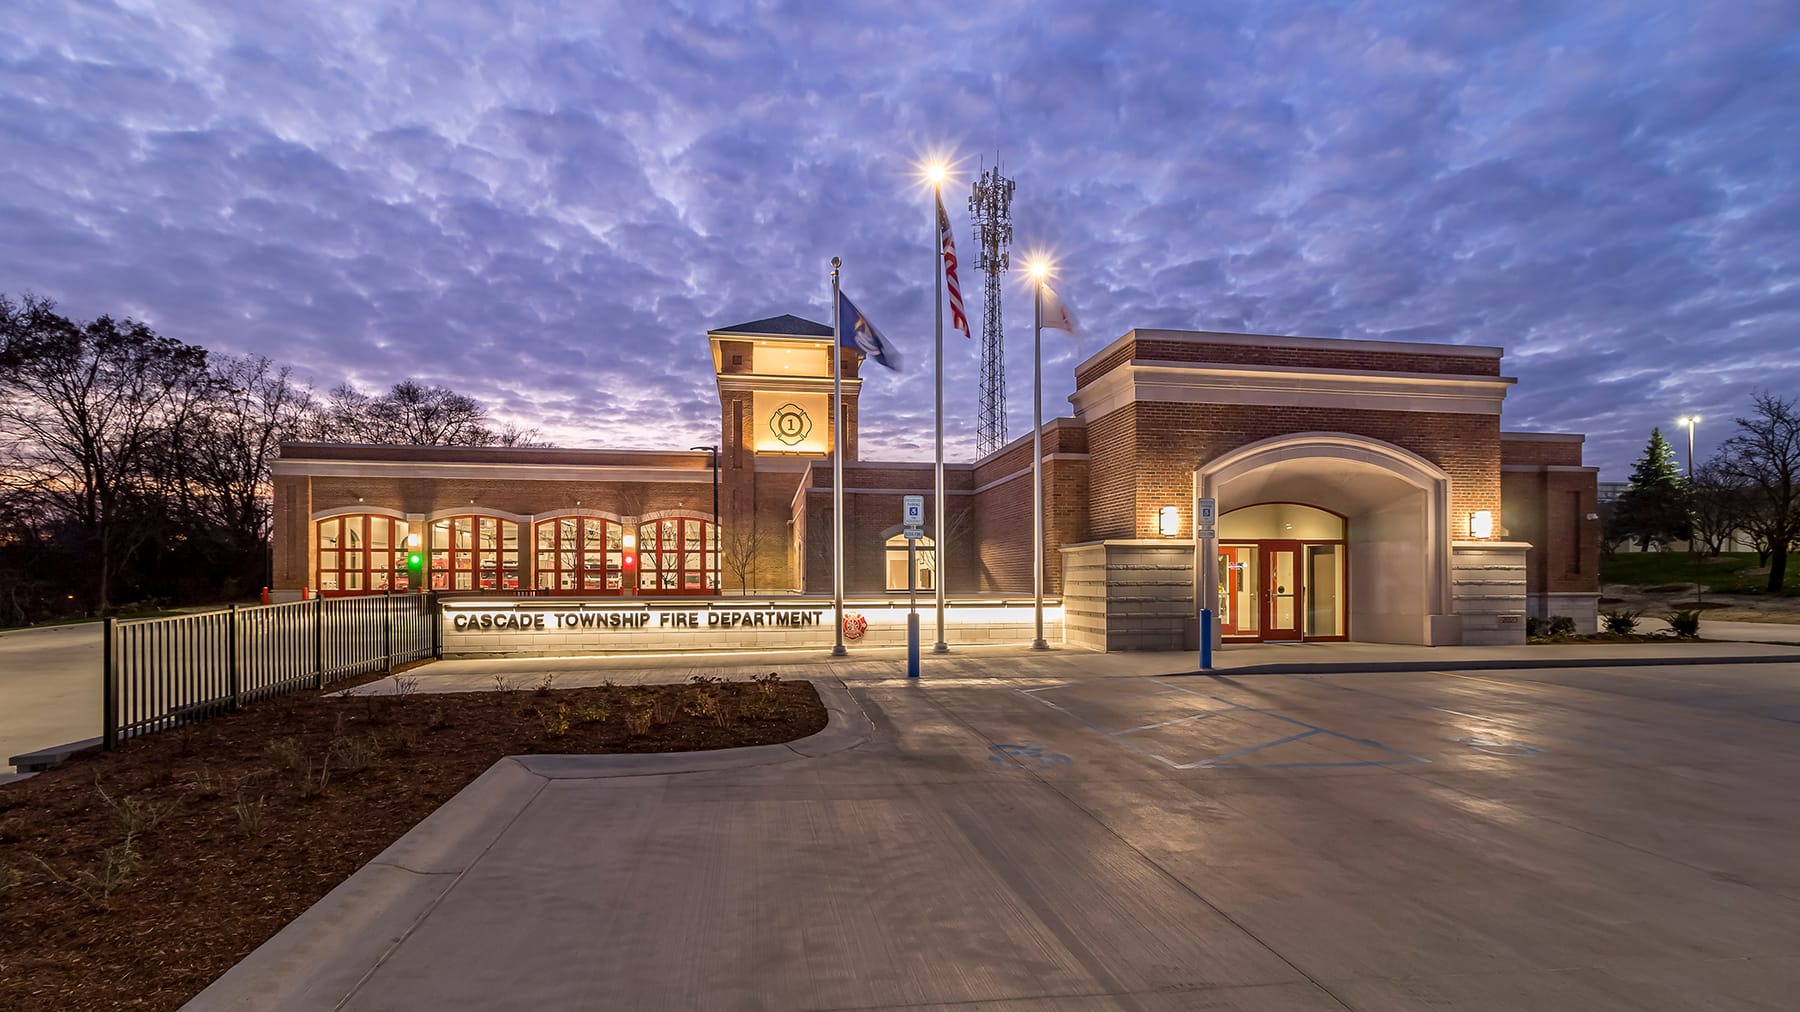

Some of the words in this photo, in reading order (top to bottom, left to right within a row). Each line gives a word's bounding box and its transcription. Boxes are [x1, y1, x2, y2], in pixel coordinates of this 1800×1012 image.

[787, 418, 795, 431] 1
[454, 614, 545, 631] CASCADE
[554, 613, 651, 628] TOWNSHIP
[660, 612, 699, 627] FIRE
[708, 611, 823, 628] DEPARTMENT
